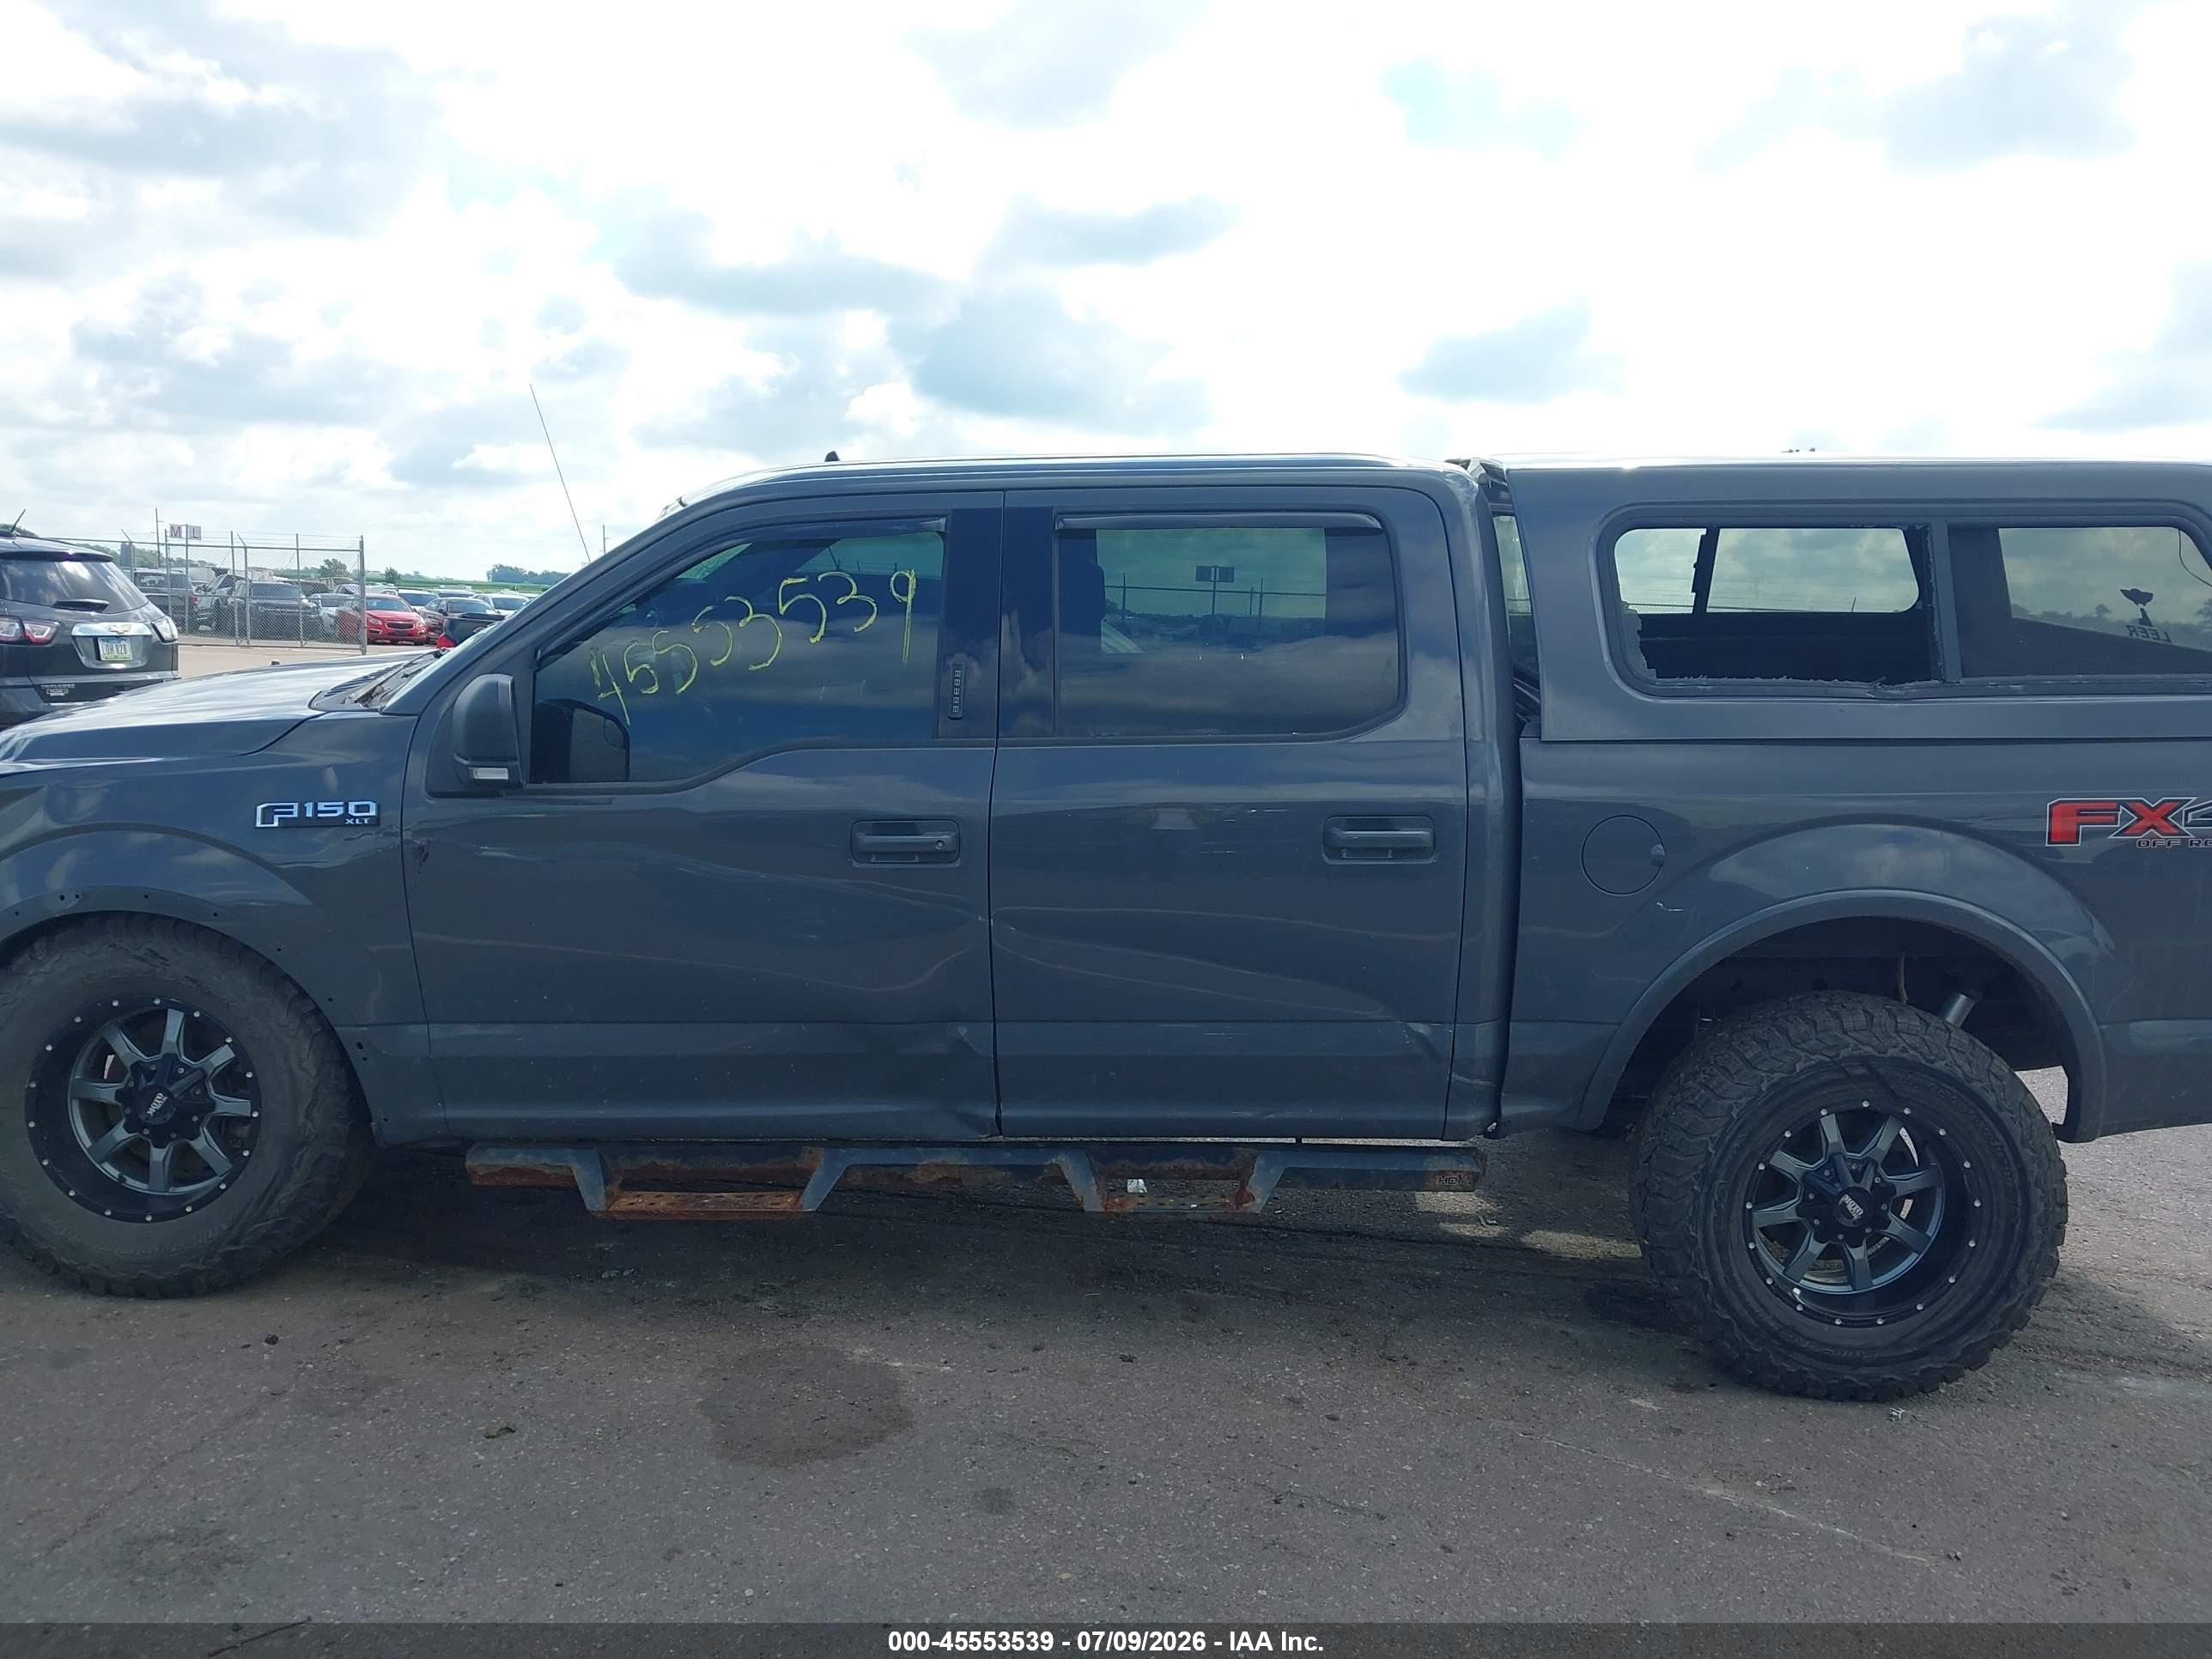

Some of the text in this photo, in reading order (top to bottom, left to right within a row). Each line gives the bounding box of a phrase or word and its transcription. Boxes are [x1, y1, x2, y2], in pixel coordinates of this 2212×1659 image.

[171, 525, 181, 537] M
[589, 568, 917, 726] 45553539
[2136, 838, 2180, 848] OFF
